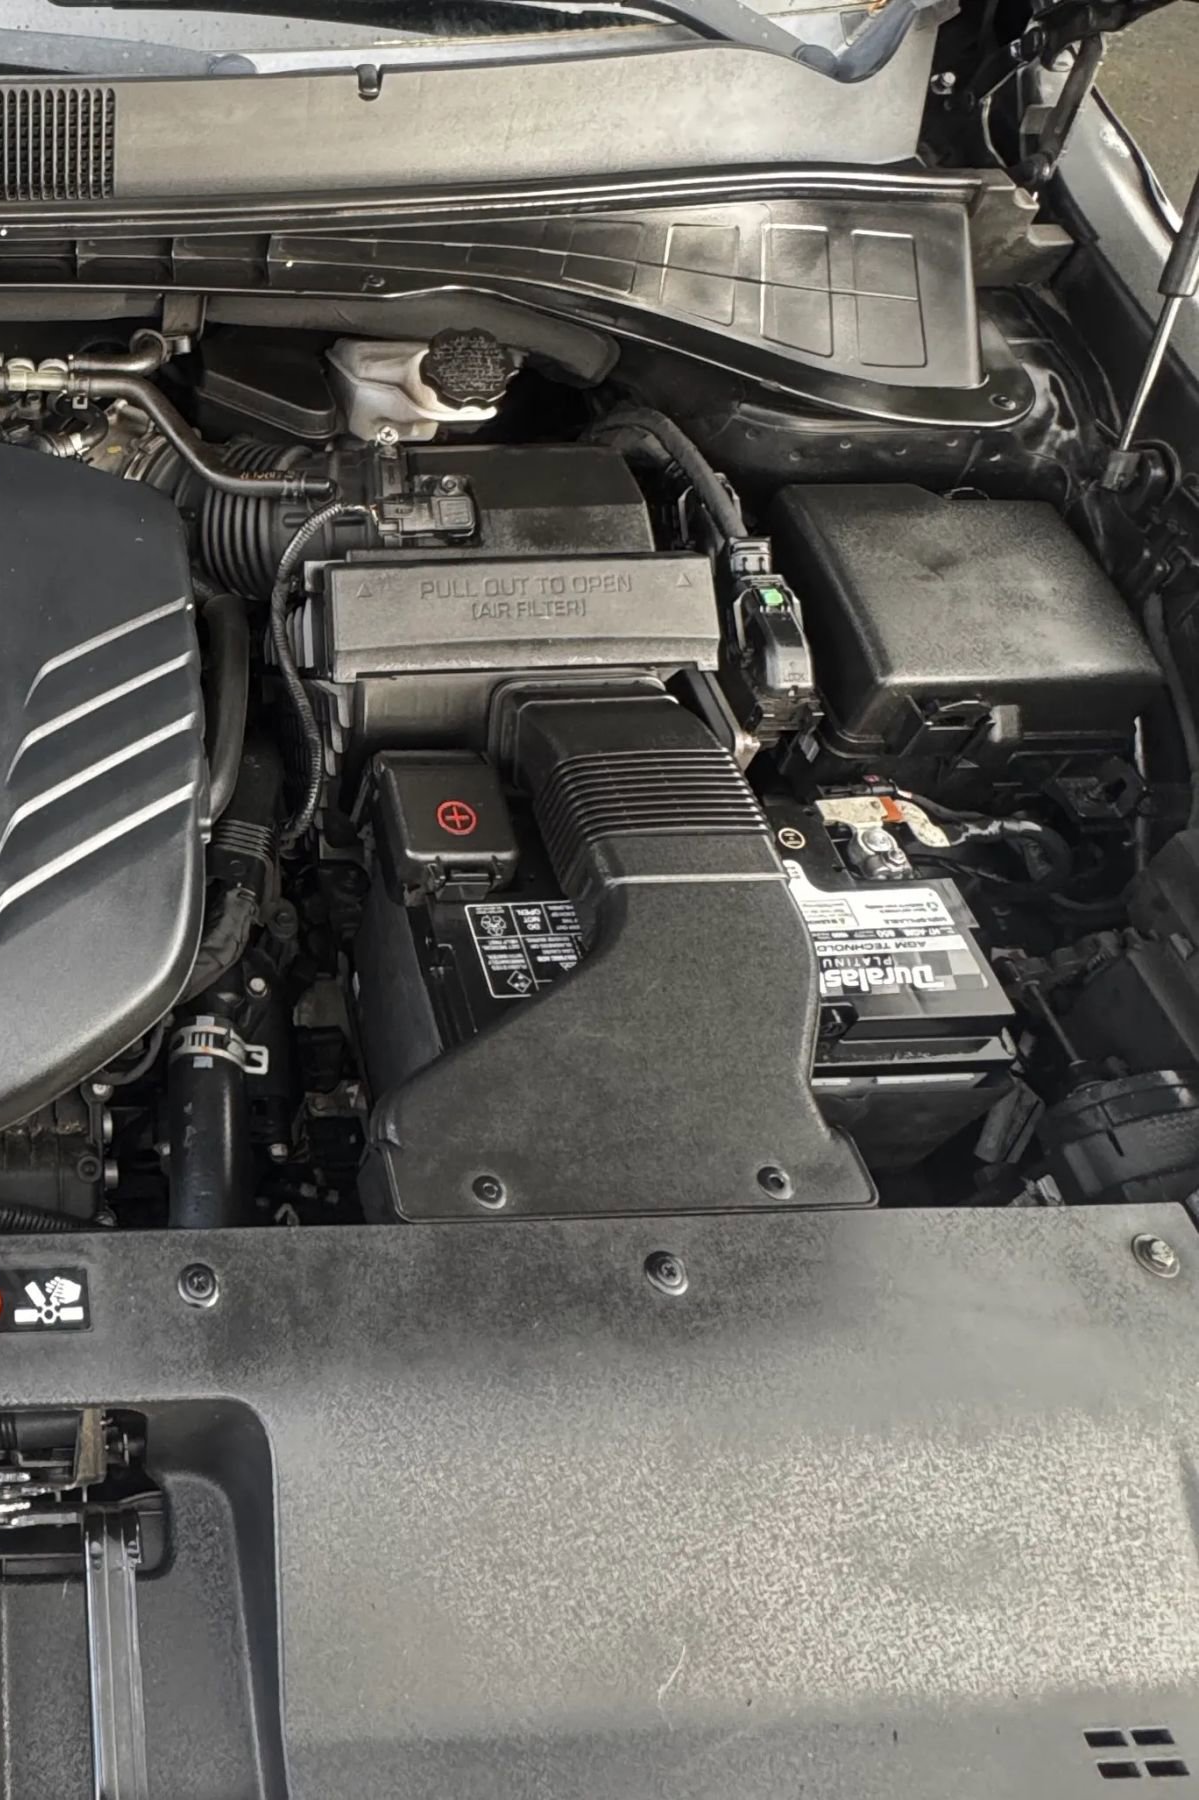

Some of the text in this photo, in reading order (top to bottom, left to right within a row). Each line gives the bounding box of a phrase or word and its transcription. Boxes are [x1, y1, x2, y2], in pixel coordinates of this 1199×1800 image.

[420, 573, 633, 600] PULL OUT TO OPEN
[895, 940, 926, 949] AGM
